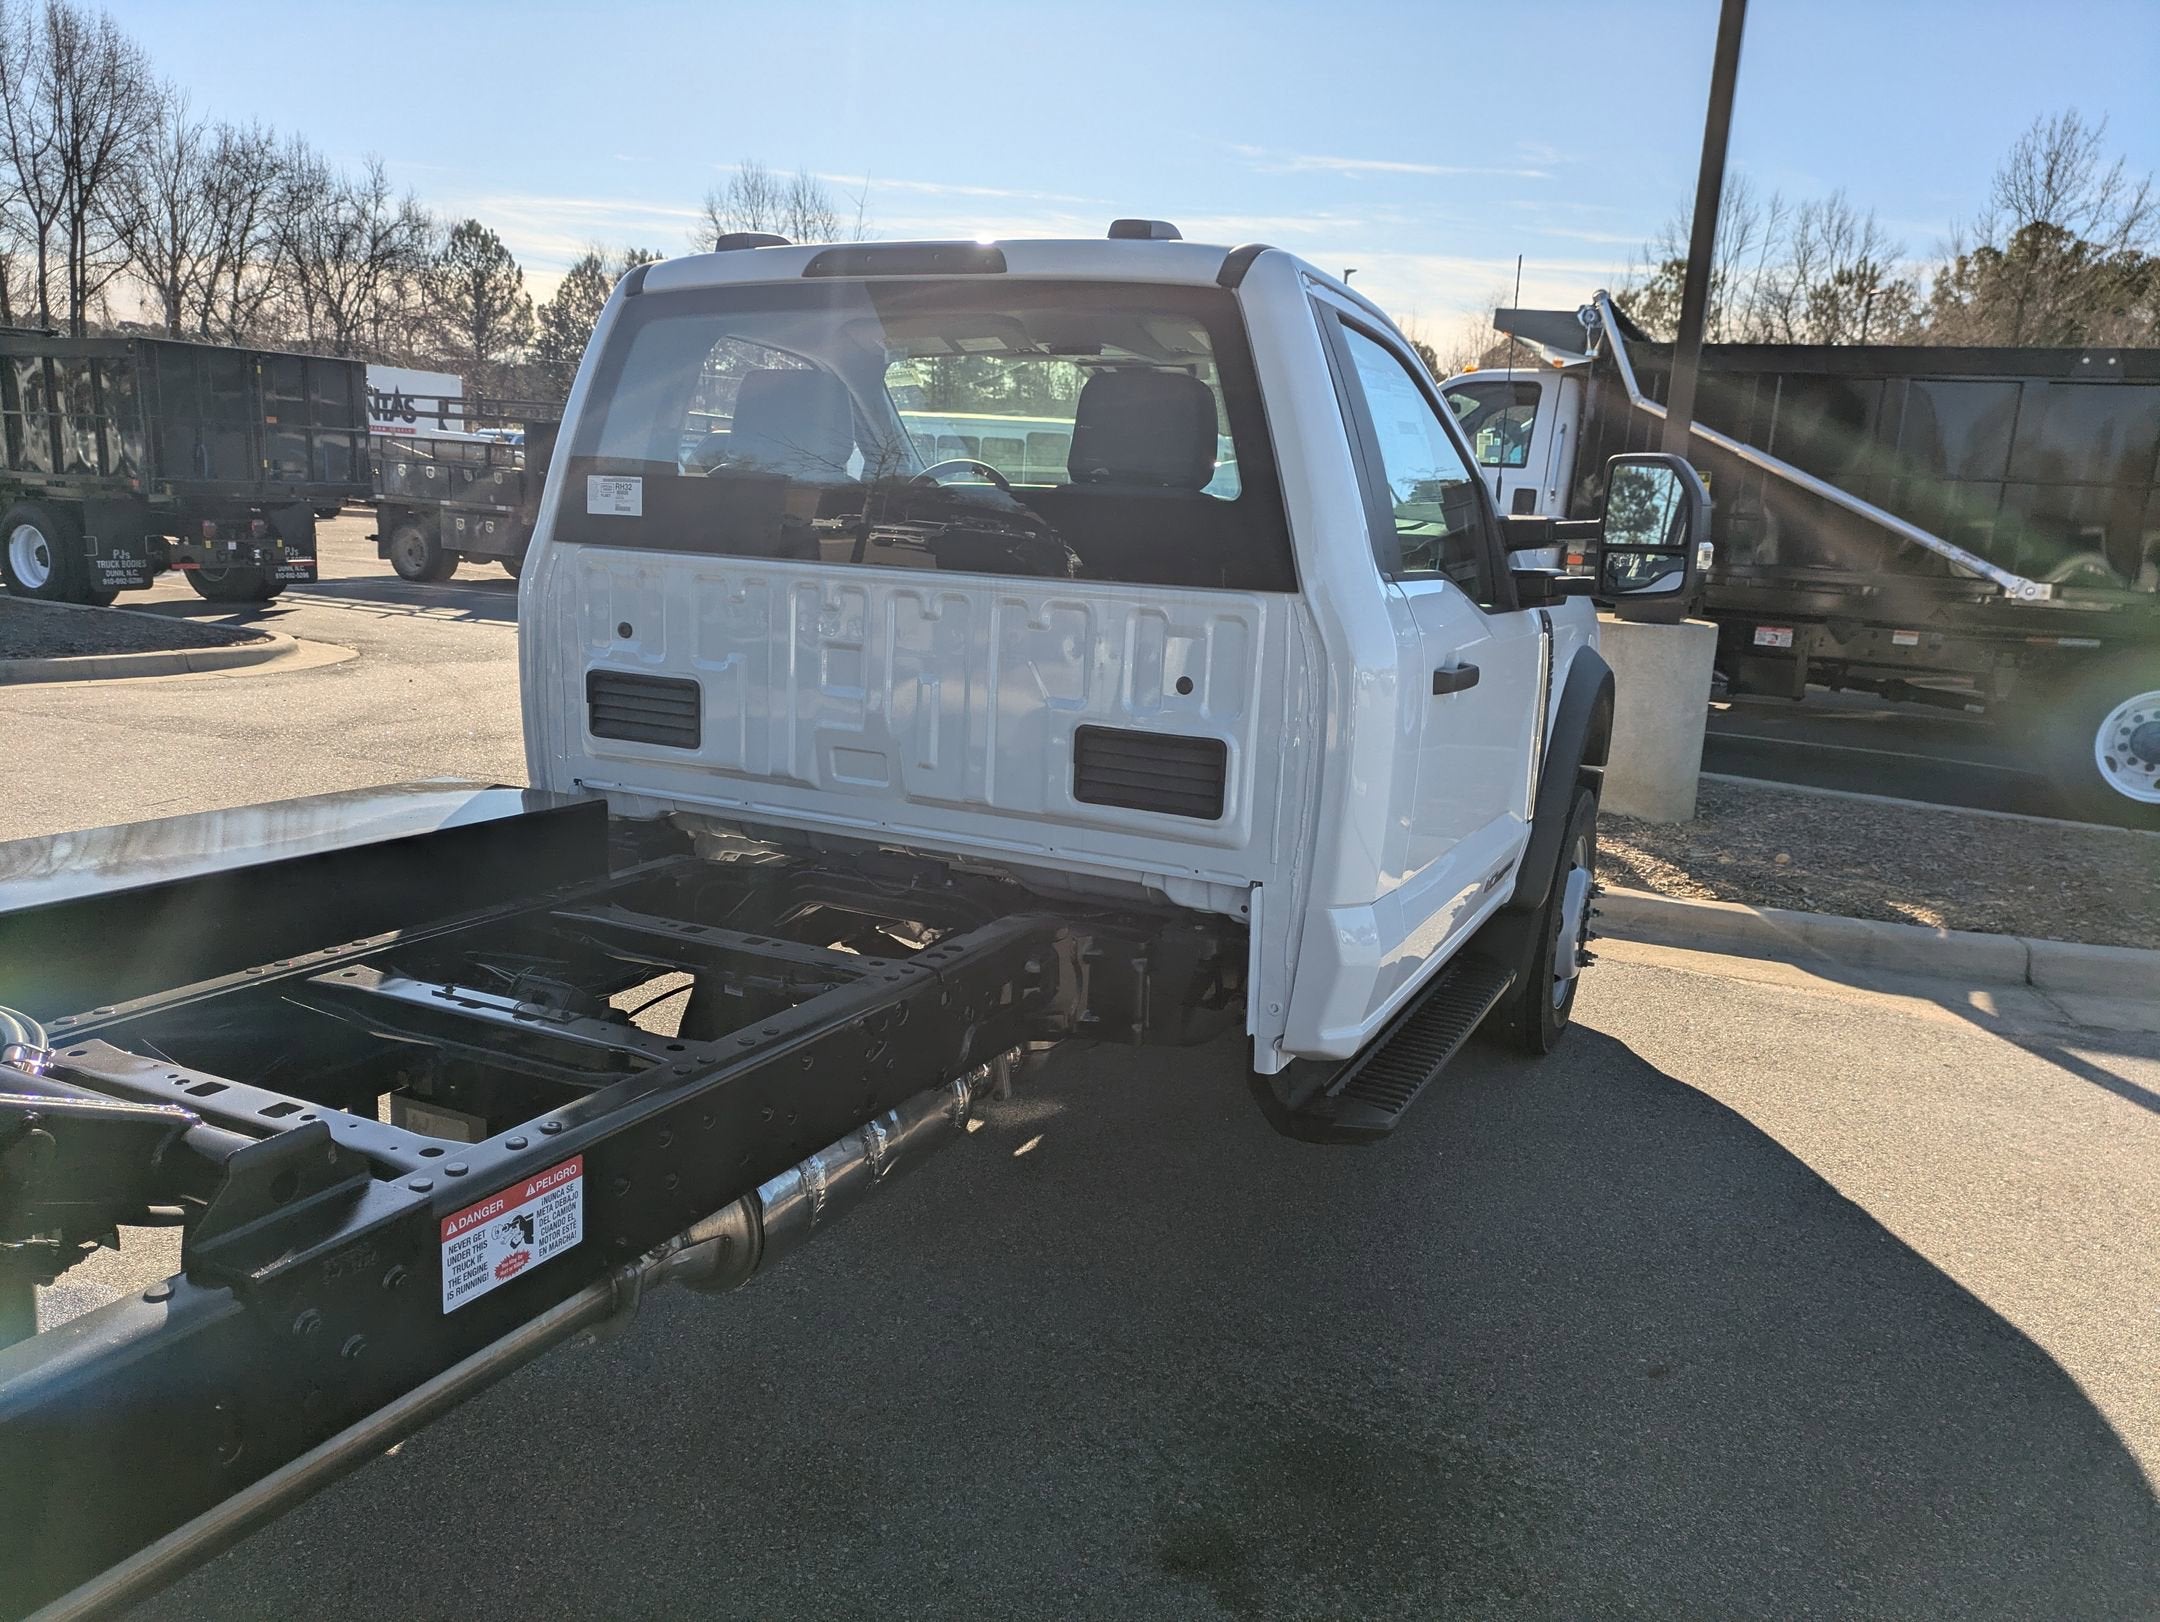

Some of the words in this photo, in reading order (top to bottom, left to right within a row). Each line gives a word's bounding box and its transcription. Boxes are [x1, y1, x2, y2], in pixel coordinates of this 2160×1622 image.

[616, 482, 632, 490] RH32
[96, 560, 120, 568] TRUCK
[121, 560, 147, 568] BODIES
[536, 1164, 577, 1191] PELIGRO
[566, 1182, 574, 1192] SE
[458, 1199, 504, 1229] DANGER
[536, 1204, 554, 1218] META
[554, 1190, 579, 1209] DEBAJO
[538, 1216, 551, 1228] DEL
[552, 1201, 576, 1220] CAMIÓN
[540, 1218, 566, 1237] CUANDO
[567, 1214, 576, 1224] EL
[448, 1236, 472, 1256] NEVER
[472, 1229, 486, 1244] GET
[538, 1231, 561, 1248] MOTOR
[538, 1247, 548, 1257] EN
[548, 1230, 577, 1254] MARCHA!
[447, 1248, 471, 1267] UNDER
[472, 1240, 488, 1255] THIS
[452, 1259, 476, 1276] TRUCK
[477, 1253, 484, 1264] IF
[447, 1289, 454, 1301] IS
[456, 1272, 489, 1296] RUNNING!
[448, 1275, 462, 1289] THE
[463, 1261, 488, 1282] ENGINE
